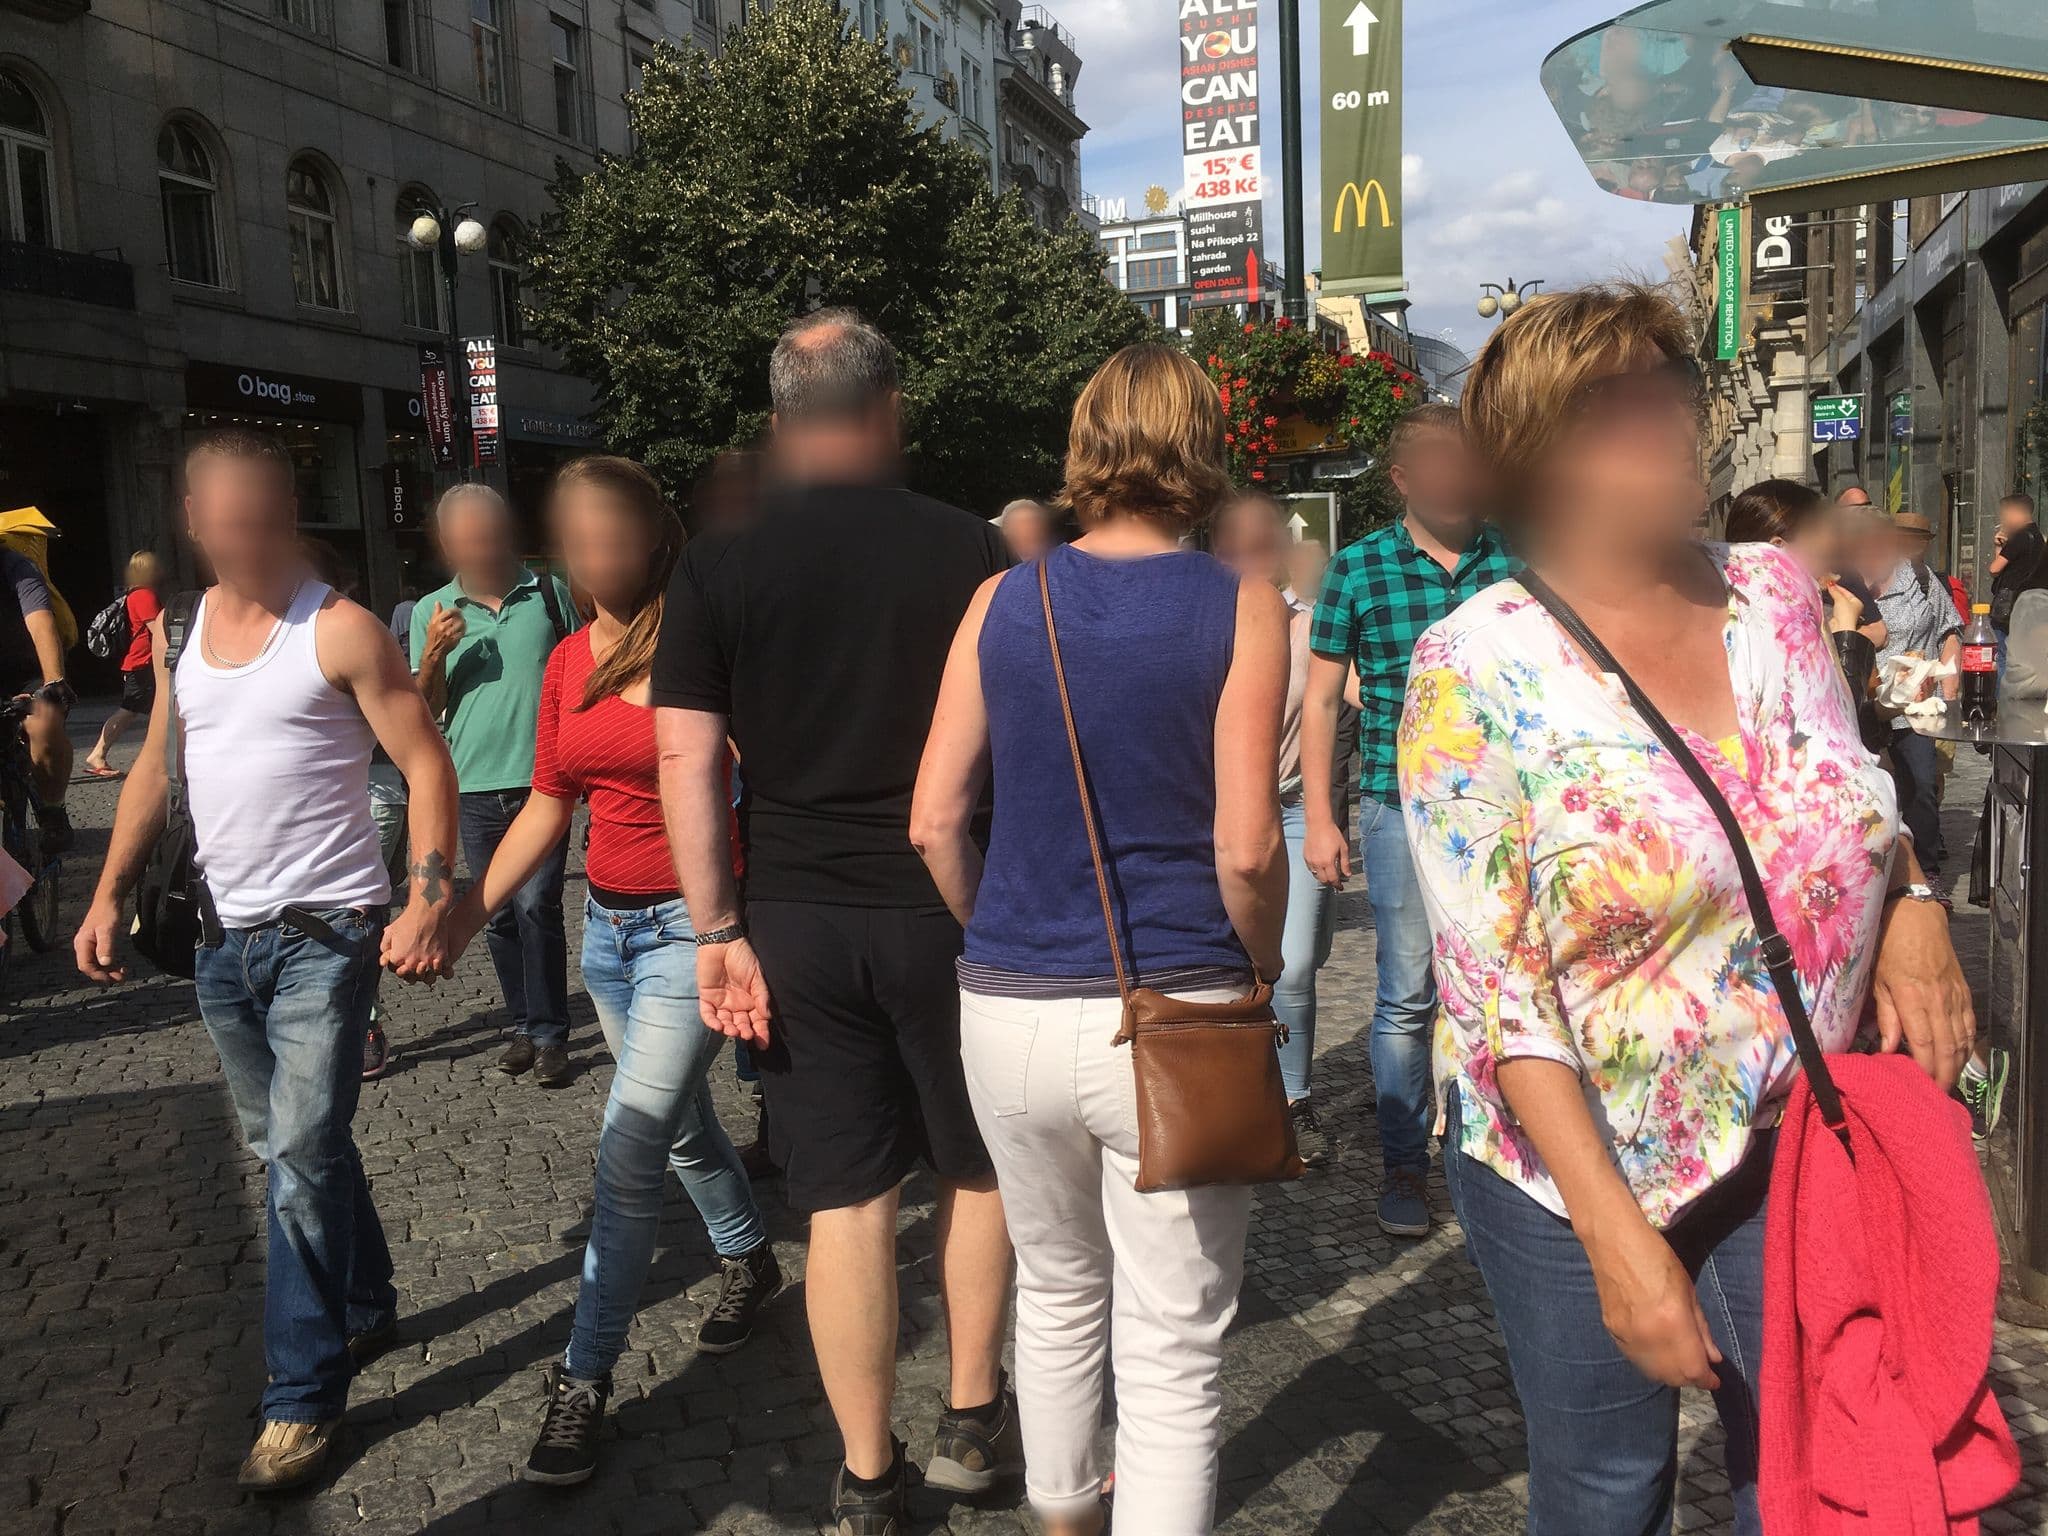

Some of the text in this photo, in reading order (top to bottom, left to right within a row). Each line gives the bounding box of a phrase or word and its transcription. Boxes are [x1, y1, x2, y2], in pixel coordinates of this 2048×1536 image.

[1184, 12, 1252, 32] SUSHI
[1180, 26, 1257, 61] YOU
[1183, 57, 1256, 76] ASIAN DISHES
[1182, 71, 1257, 105] CAN
[1332, 90, 1390, 110] 60 m
[1184, 100, 1256, 120] DESERTS
[1186, 115, 1257, 149] EAT
[1241, 154, 1254, 170] €
[1195, 176, 1258, 198] 438 Kč
[1190, 210, 1238, 223] Millhouse
[1190, 223, 1216, 236] sushi
[1191, 240, 1205, 249] Na
[1246, 232, 1258, 242] 22
[1192, 250, 1227, 262] zahrada
[1199, 264, 1231, 277] garden
[1194, 279, 1217, 289] OPEN
[1725, 218, 1734, 350] UNITED COLORS OF BENETTON
[466, 340, 495, 352] ALL
[467, 357, 495, 370] YOU
[238, 374, 254, 395] O
[469, 375, 496, 387] CAN
[471, 392, 497, 405] EAT
